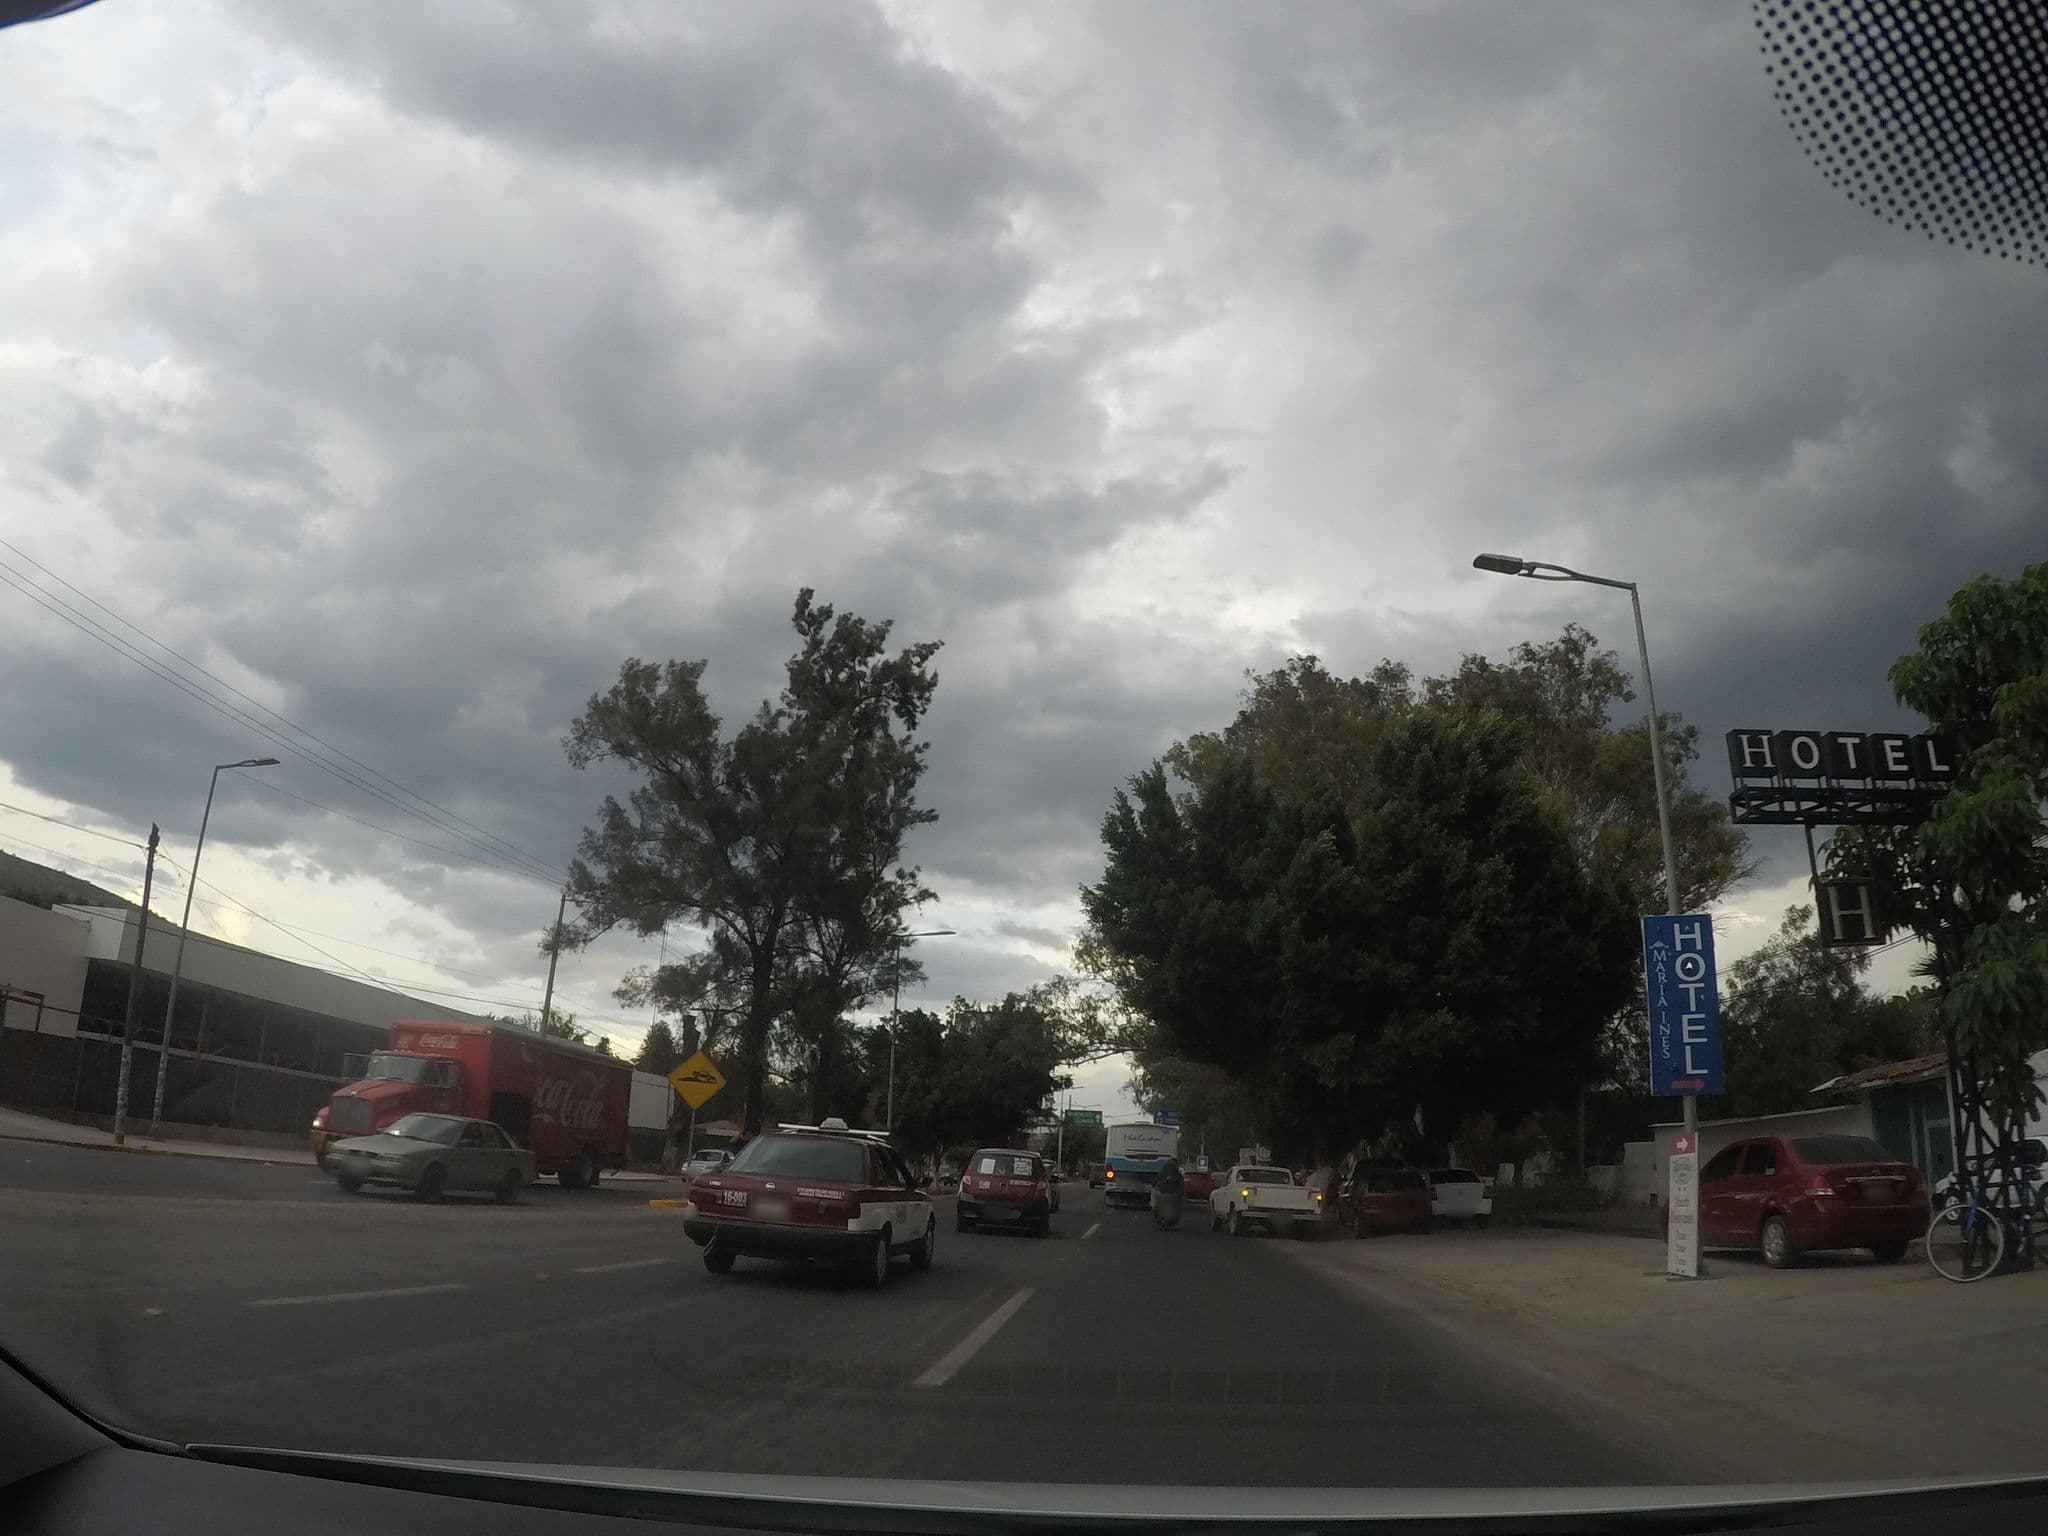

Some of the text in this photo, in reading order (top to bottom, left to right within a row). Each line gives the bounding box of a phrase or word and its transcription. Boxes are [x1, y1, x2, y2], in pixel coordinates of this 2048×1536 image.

[1737, 733, 1951, 772] HOTEL
[1827, 885, 1877, 940] H
[1672, 921, 1709, 1076] HOTEL
